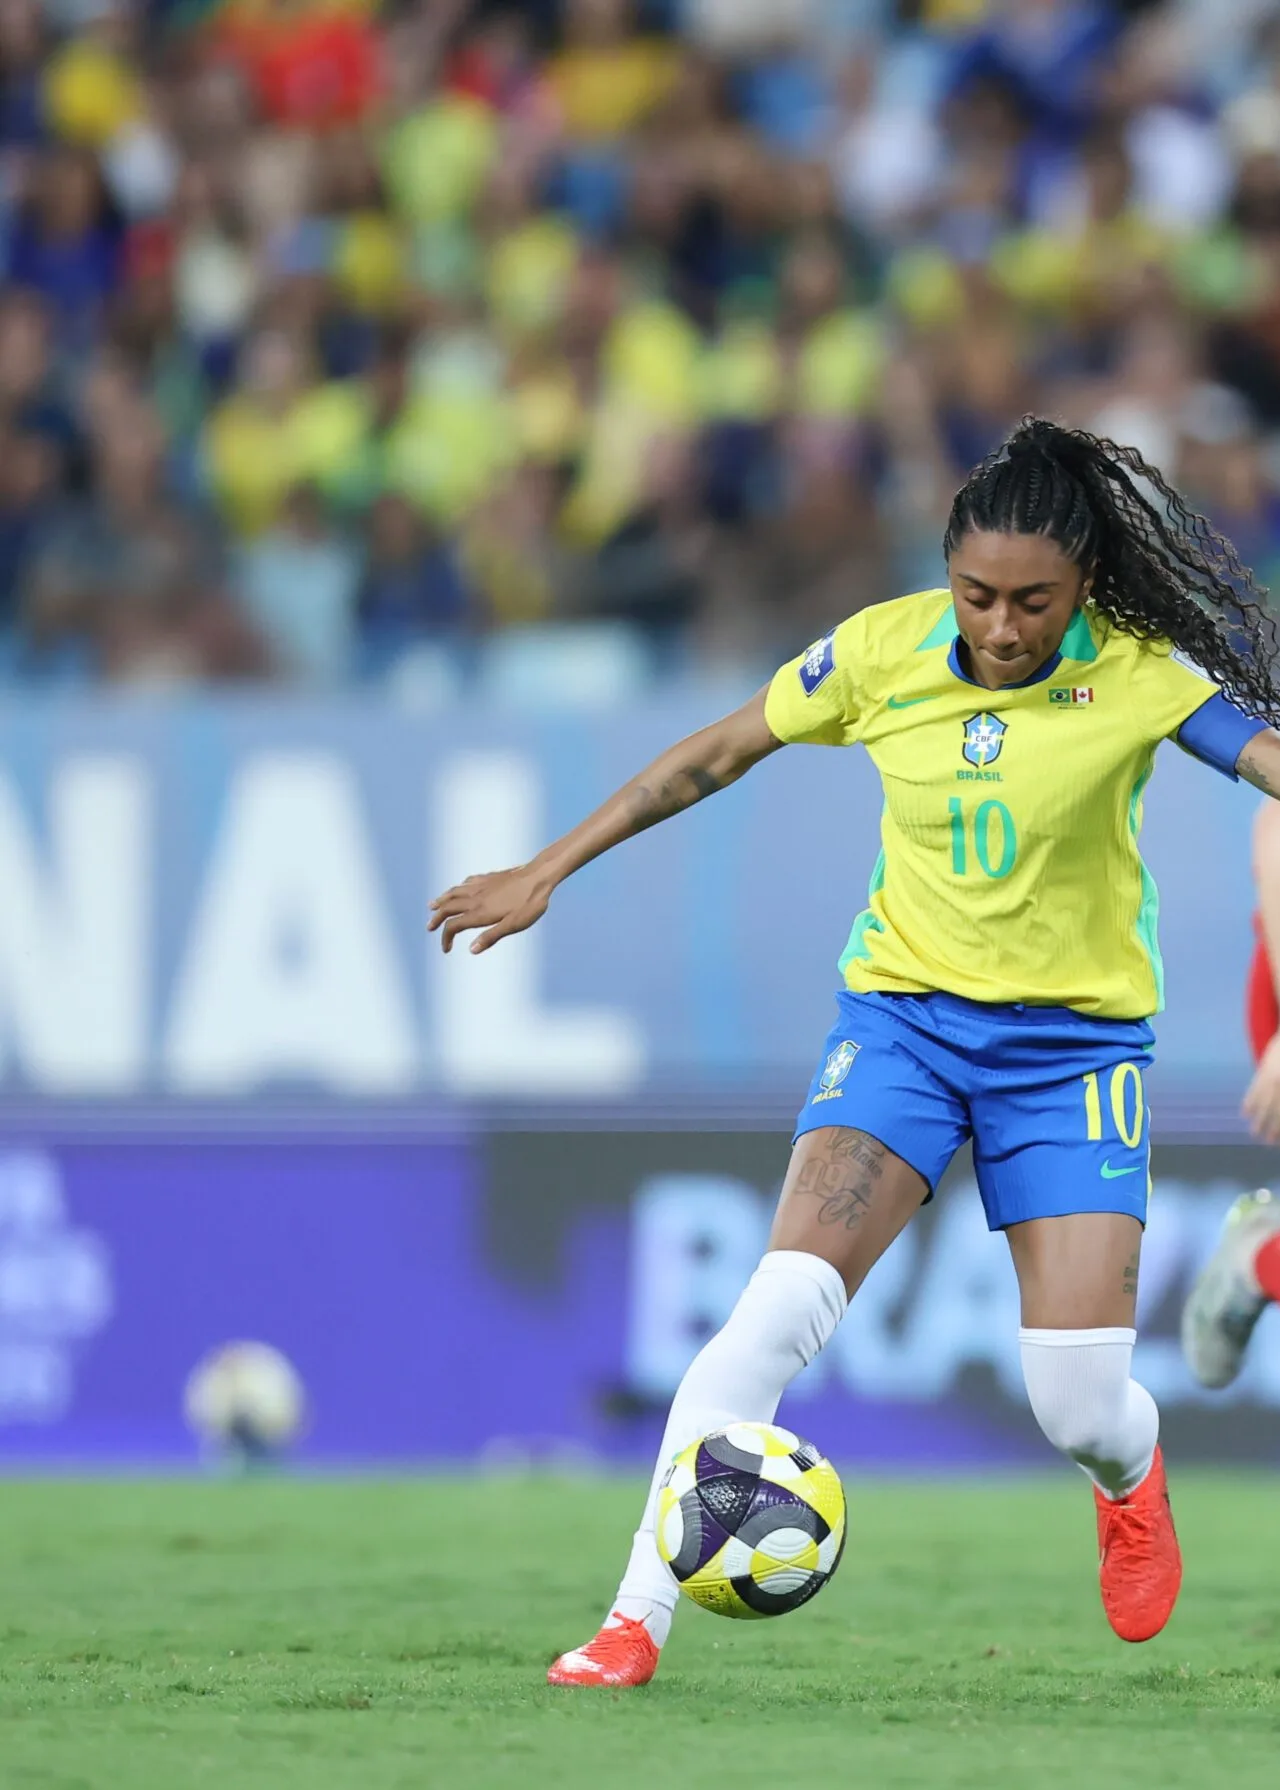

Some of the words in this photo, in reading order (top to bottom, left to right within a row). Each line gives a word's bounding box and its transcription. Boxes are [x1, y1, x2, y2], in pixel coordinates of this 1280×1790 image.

[975, 735, 993, 743] CBF
[956, 770, 1003, 782] BRASIL
[948, 796, 1017, 878] 10
[812, 1088, 844, 1105] BRASIL
[1083, 1062, 1144, 1149] 10
